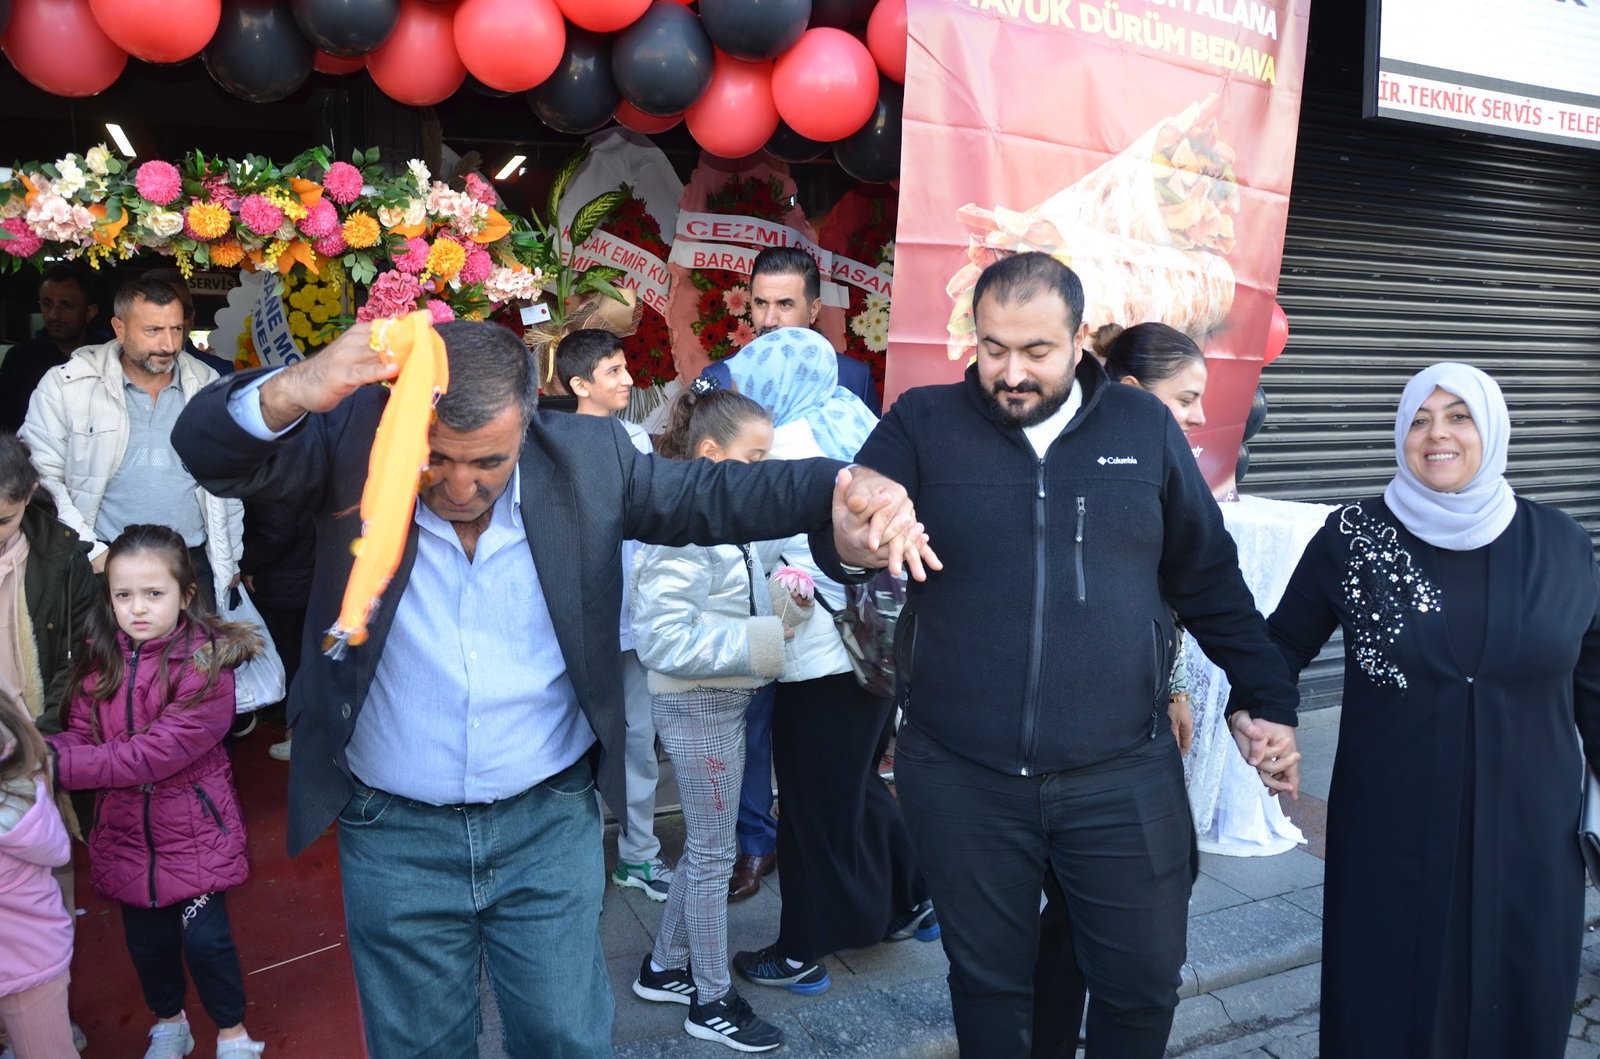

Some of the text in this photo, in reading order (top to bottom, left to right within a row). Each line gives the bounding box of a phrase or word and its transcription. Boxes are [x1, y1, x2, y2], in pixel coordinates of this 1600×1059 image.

[1197, 0, 1277, 40] ALANA
[969, 0, 1276, 85] AVUK DÜRÜM BEDAVA
[1481, 98, 1542, 125] SERVİS
[686, 220, 787, 247] CEZMİ
[610, 245, 648, 274] EMİR
[189, 276, 234, 290] SERVİS
[1107, 456, 1138, 464] Columbia
